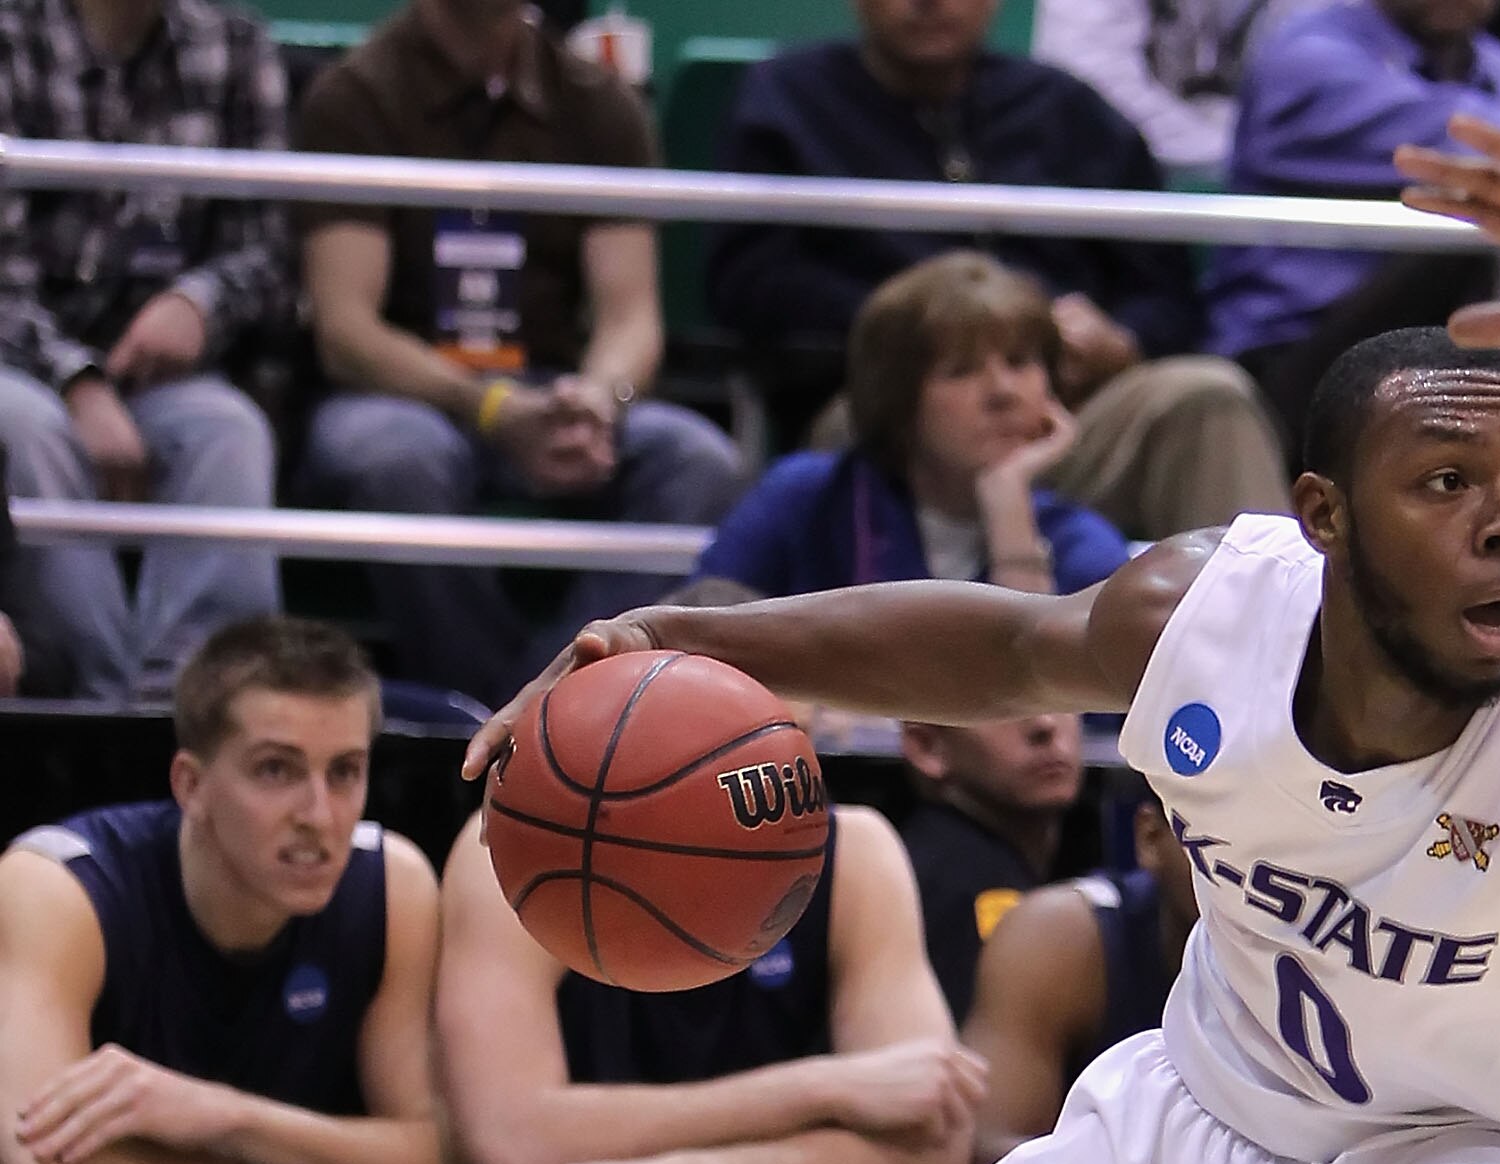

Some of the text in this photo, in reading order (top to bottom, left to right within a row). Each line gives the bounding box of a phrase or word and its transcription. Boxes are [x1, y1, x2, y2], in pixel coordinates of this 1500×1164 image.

[1170, 726, 1206, 767] NCAA
[1171, 808, 1499, 986] K-STATE
[1275, 951, 1374, 1105] 0
